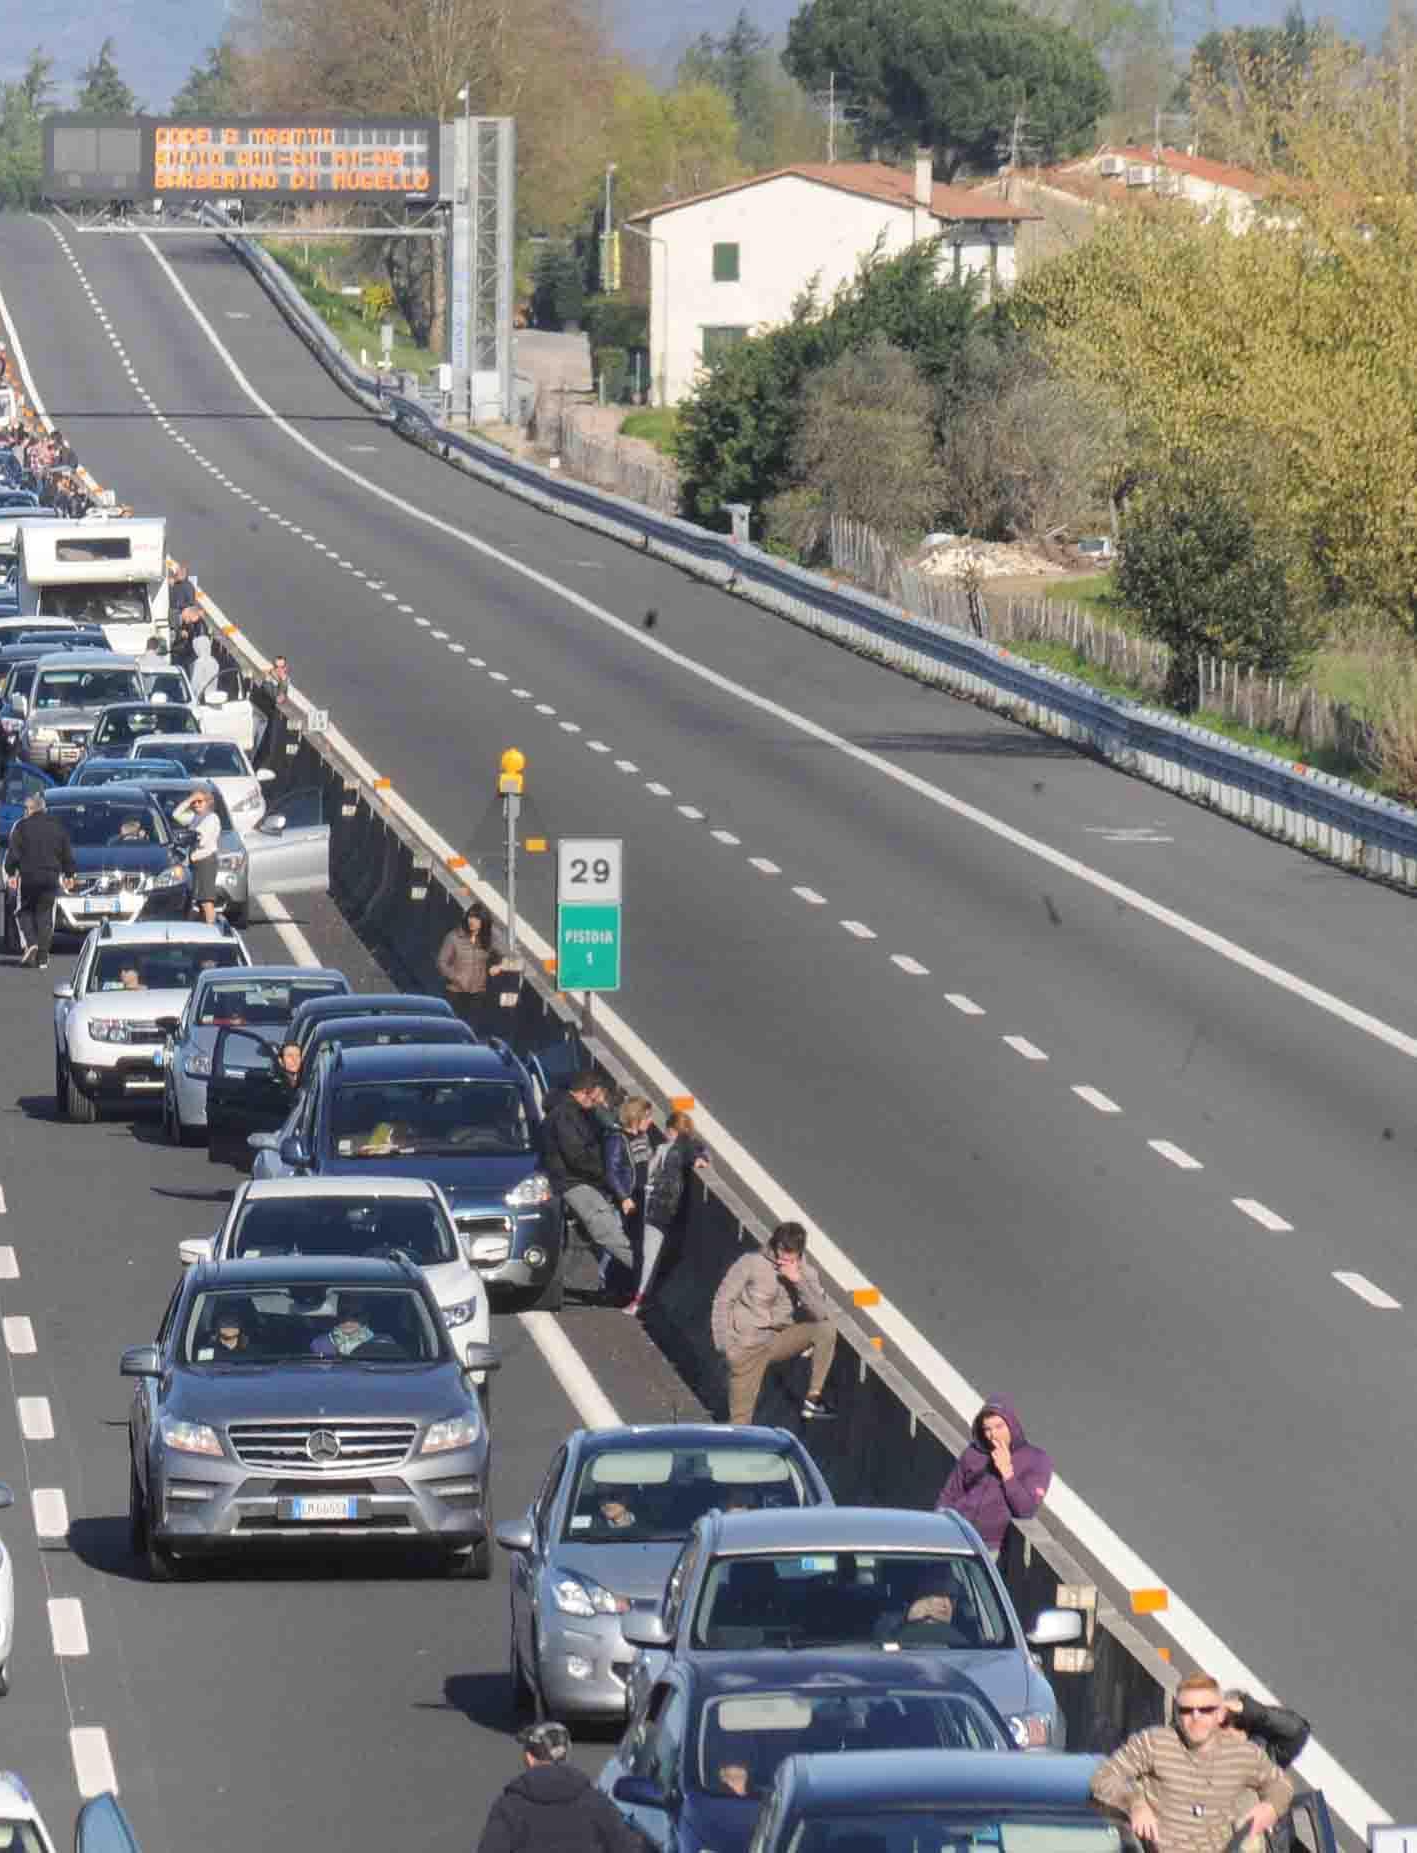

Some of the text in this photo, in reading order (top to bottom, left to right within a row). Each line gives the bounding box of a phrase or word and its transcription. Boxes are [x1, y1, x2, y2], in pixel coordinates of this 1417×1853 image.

[154, 171, 430, 190] BARBERINO DI MUGELLO
[570, 858, 611, 884] 29
[564, 928, 615, 945] PISTOIA
